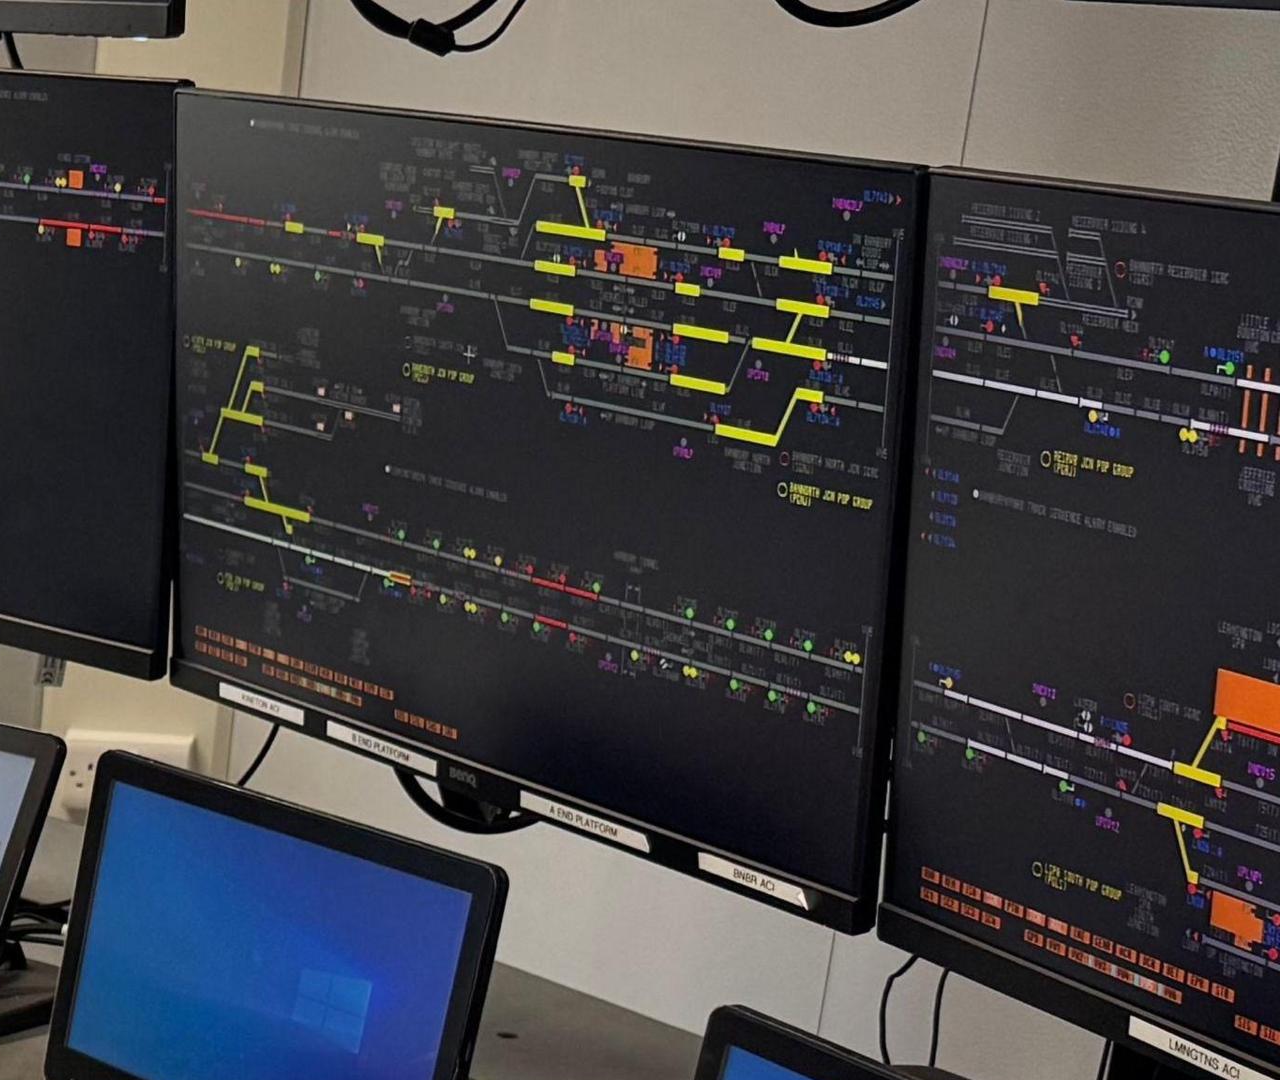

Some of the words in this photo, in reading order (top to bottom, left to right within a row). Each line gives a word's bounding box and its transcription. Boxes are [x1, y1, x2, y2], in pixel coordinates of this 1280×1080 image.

[1080, 455, 1095, 470] JCN
[1096, 458, 1110, 474] POP
[1112, 463, 1135, 478] GROUP
[837, 492, 851, 505] POP
[852, 495, 874, 510] GROUP
[358, 735, 373, 749] END
[373, 740, 410, 762] PLATFORM
[448, 767, 477, 788] BenQ
[549, 805, 555, 814] A
[557, 808, 574, 822] END
[575, 814, 618, 837] PLATFORM
[733, 868, 758, 885] BNBR
[760, 878, 776, 892] ACI
[1085, 877, 1099, 892] POP
[1101, 883, 1123, 901] GROUP
[1168, 1038, 1220, 1070] LMNGTNS
[1221, 1063, 1241, 1079] ACI
